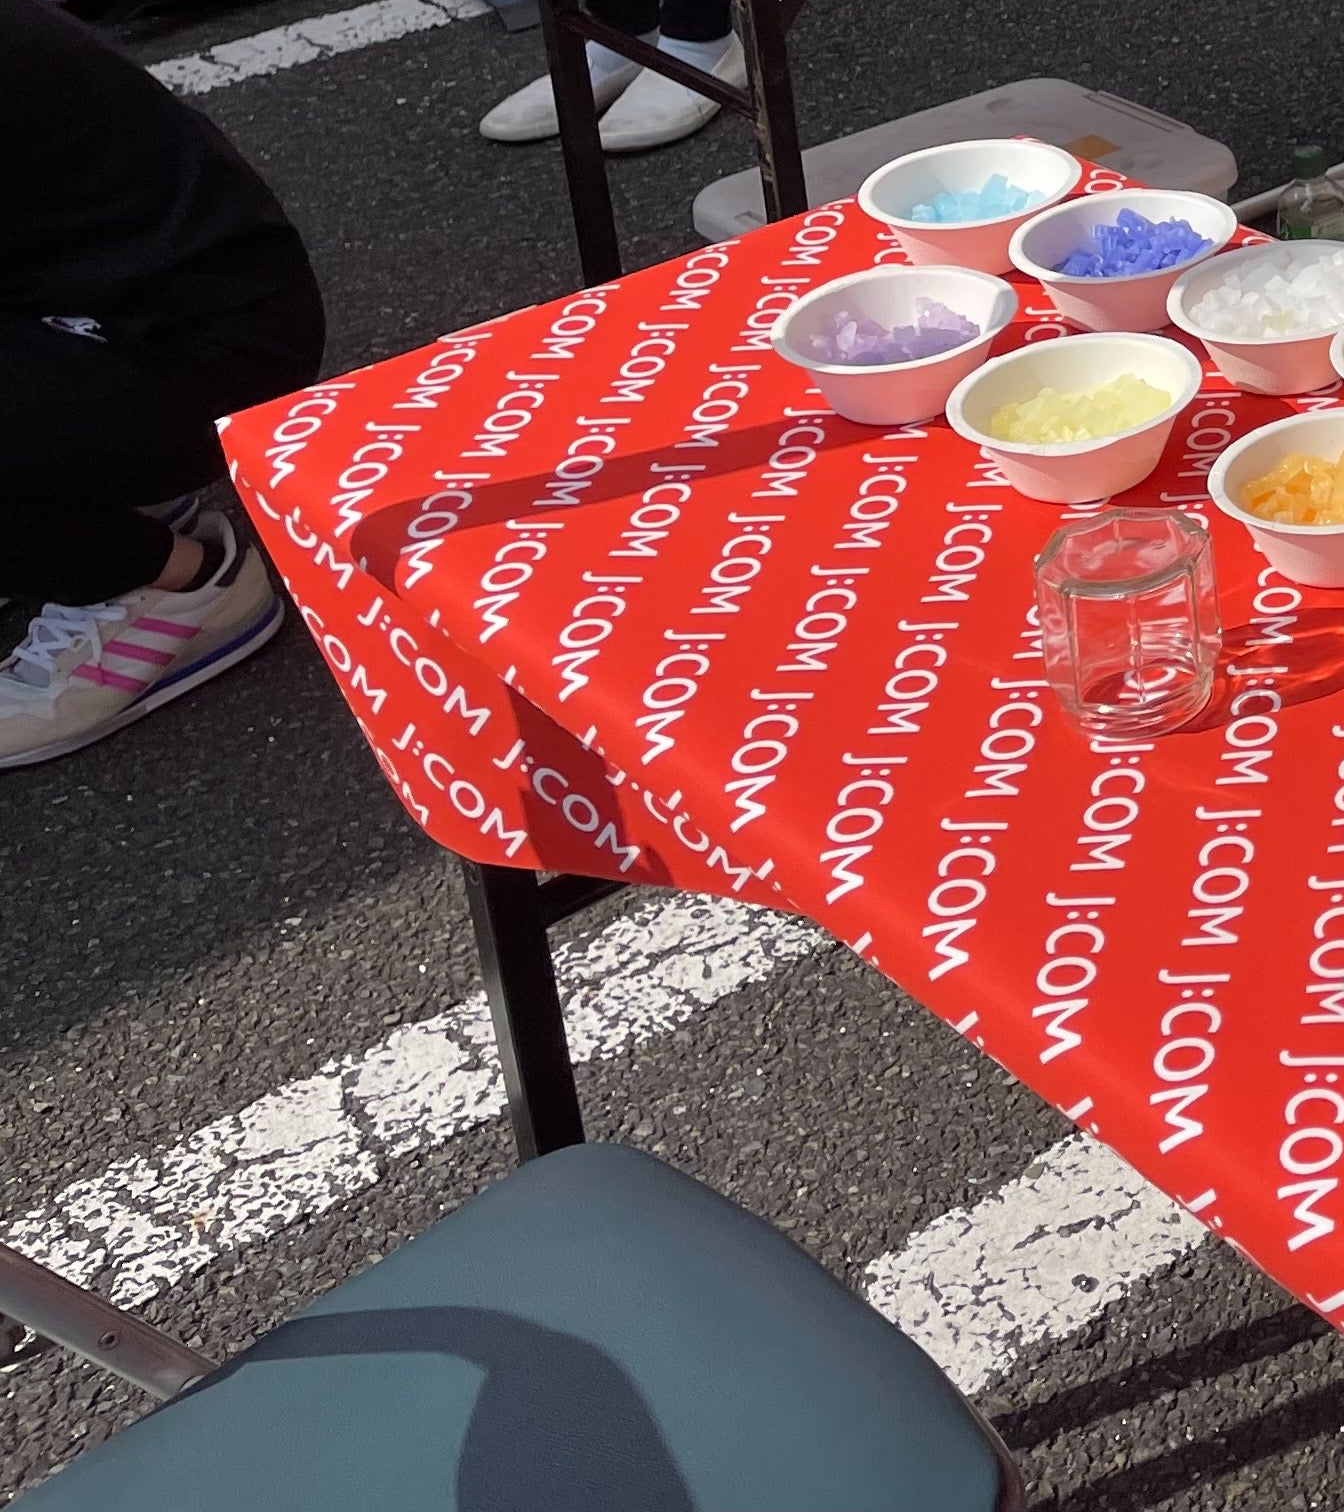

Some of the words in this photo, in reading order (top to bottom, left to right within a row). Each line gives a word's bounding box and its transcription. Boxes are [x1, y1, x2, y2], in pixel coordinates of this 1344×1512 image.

[660, 240, 740, 311] J:COM
[780, 197, 856, 266] J:COM
[392, 332, 493, 409] J:COM
[531, 284, 620, 359] J:COM
[600, 322, 689, 402] J:COM
[265, 380, 356, 488] J:COM
[461, 372, 560, 458] J:COM
[532, 417, 631, 505] J:COM
[675, 363, 762, 448] J:COM
[752, 405, 837, 498] J:COM
[330, 421, 421, 537] J:COM
[400, 470, 491, 588] J:COM
[609, 462, 706, 557] J:COM
[834, 453, 919, 549] J:COM
[479, 519, 564, 643] J:COM
[690, 513, 785, 613] J:COM
[920, 502, 1003, 604] J:COM
[302, 605, 388, 714] COM
[357, 595, 493, 736] J:COM
[552, 571, 643, 702] J:COM
[776, 565, 870, 672] J:COM
[635, 630, 726, 765] J:COM
[868, 619, 960, 735] J:COM
[1214, 663, 1289, 787] J:COM
[392, 723, 528, 858] J:COM
[724, 688, 814, 833] J:COM
[965, 677, 1049, 799] J:COM
[493, 739, 642, 873] J:COM
[819, 752, 908, 905] J:COM
[1070, 736, 1154, 872] J:COM
[921, 818, 1009, 982] J:COM
[1180, 806, 1262, 947] J:COM
[1031, 892, 1116, 1065] J:COM
[1149, 970, 1230, 1154] J:COM
